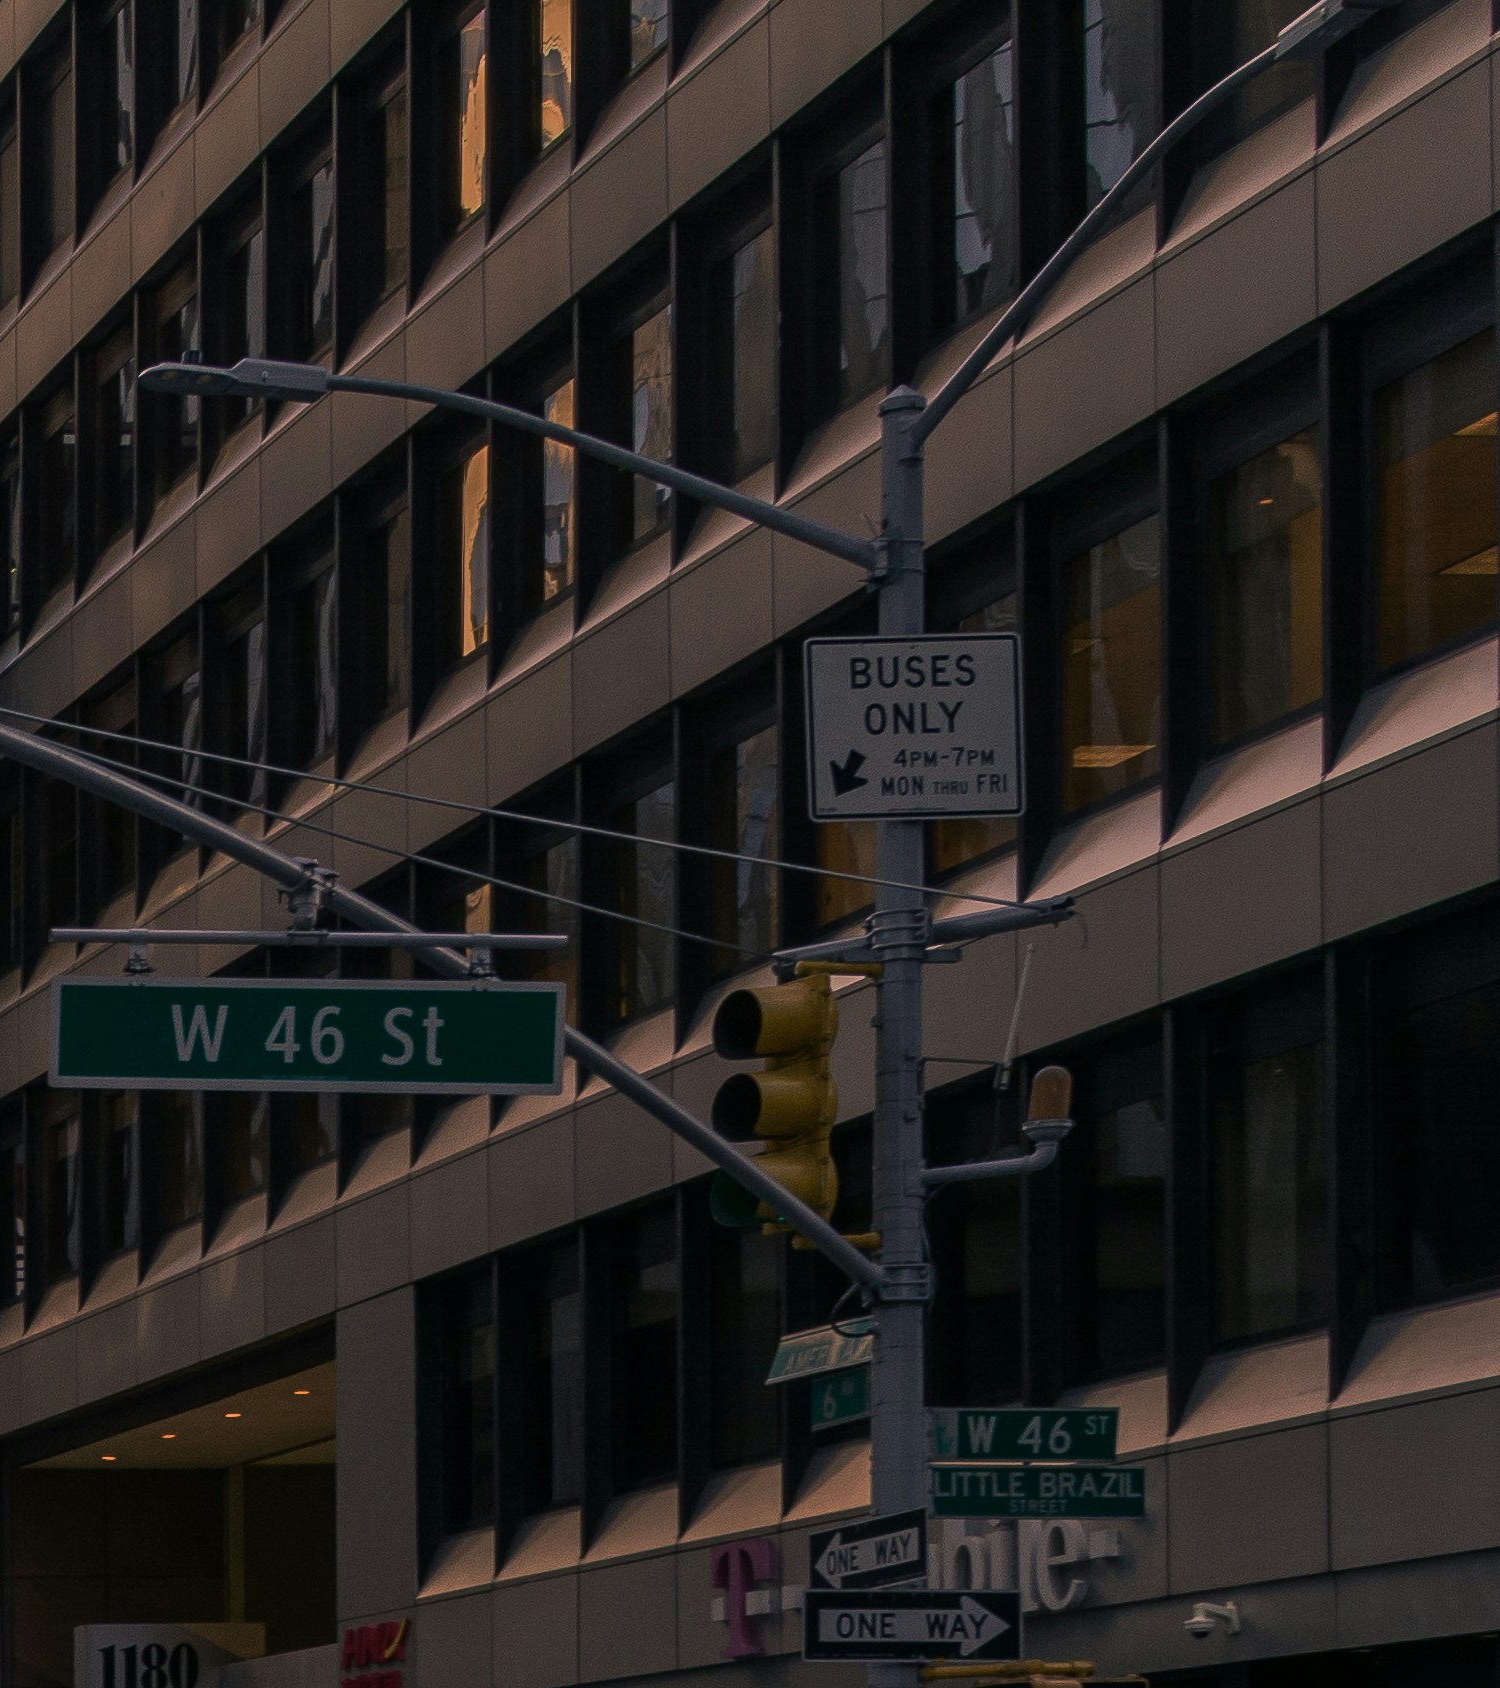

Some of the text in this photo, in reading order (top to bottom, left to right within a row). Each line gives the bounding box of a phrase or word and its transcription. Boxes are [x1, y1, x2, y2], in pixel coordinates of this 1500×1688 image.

[851, 654, 976, 689] BUSES
[865, 701, 963, 735] ONLY
[894, 747, 995, 768] 4PM-7PM
[881, 773, 1008, 797] MON THRU FRI
[171, 1003, 445, 1066] W 46 St
[823, 1384, 838, 1419] 6
[967, 1415, 1110, 1454] W 46 ST
[934, 1471, 1143, 1499] LITTLE BRAZIL
[1009, 1500, 1068, 1514] STREET
[826, 1533, 912, 1576] ONE WAY
[836, 1612, 989, 1638] ONE WAY
